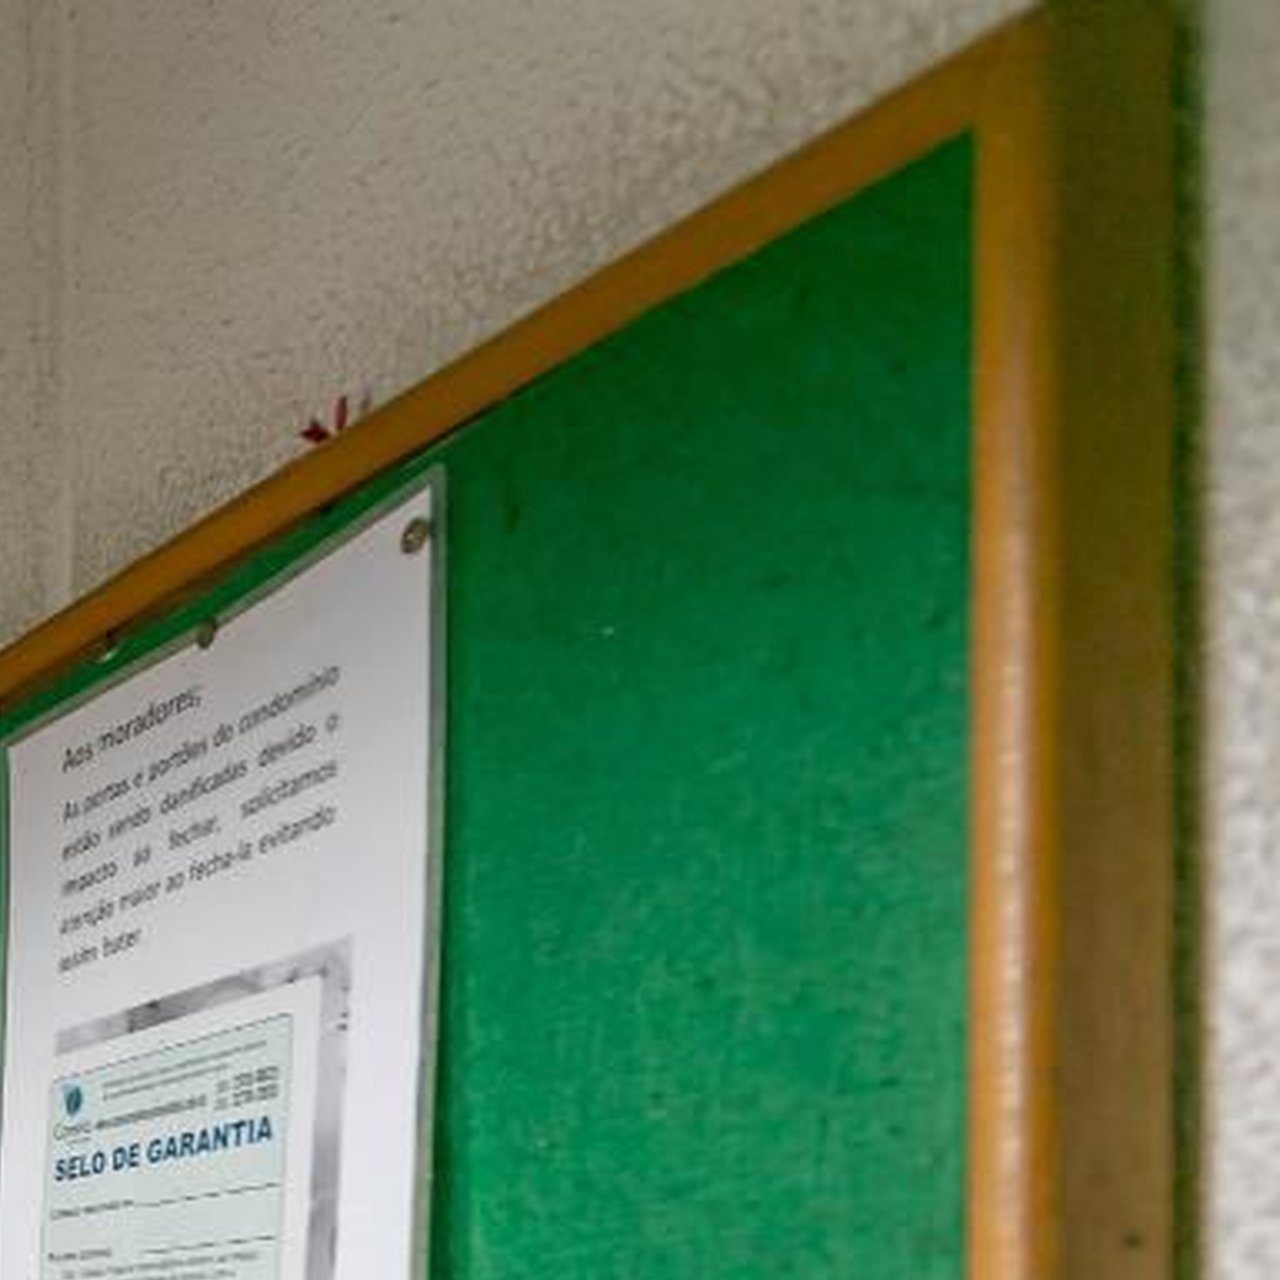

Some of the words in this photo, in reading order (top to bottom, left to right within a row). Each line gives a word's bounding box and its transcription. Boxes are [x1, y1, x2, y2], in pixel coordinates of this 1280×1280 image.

[61, 744, 95, 774] Aos
[132, 771, 144, 790] e
[213, 722, 236, 749] do
[159, 758, 249, 816] danificadas
[258, 721, 318, 769] devido
[132, 844, 152, 868] ao
[258, 802, 339, 855] evitando
[54, 1149, 107, 1183] SELO
[112, 1142, 141, 1172] DE
[145, 1114, 274, 1164] GARANTIA
